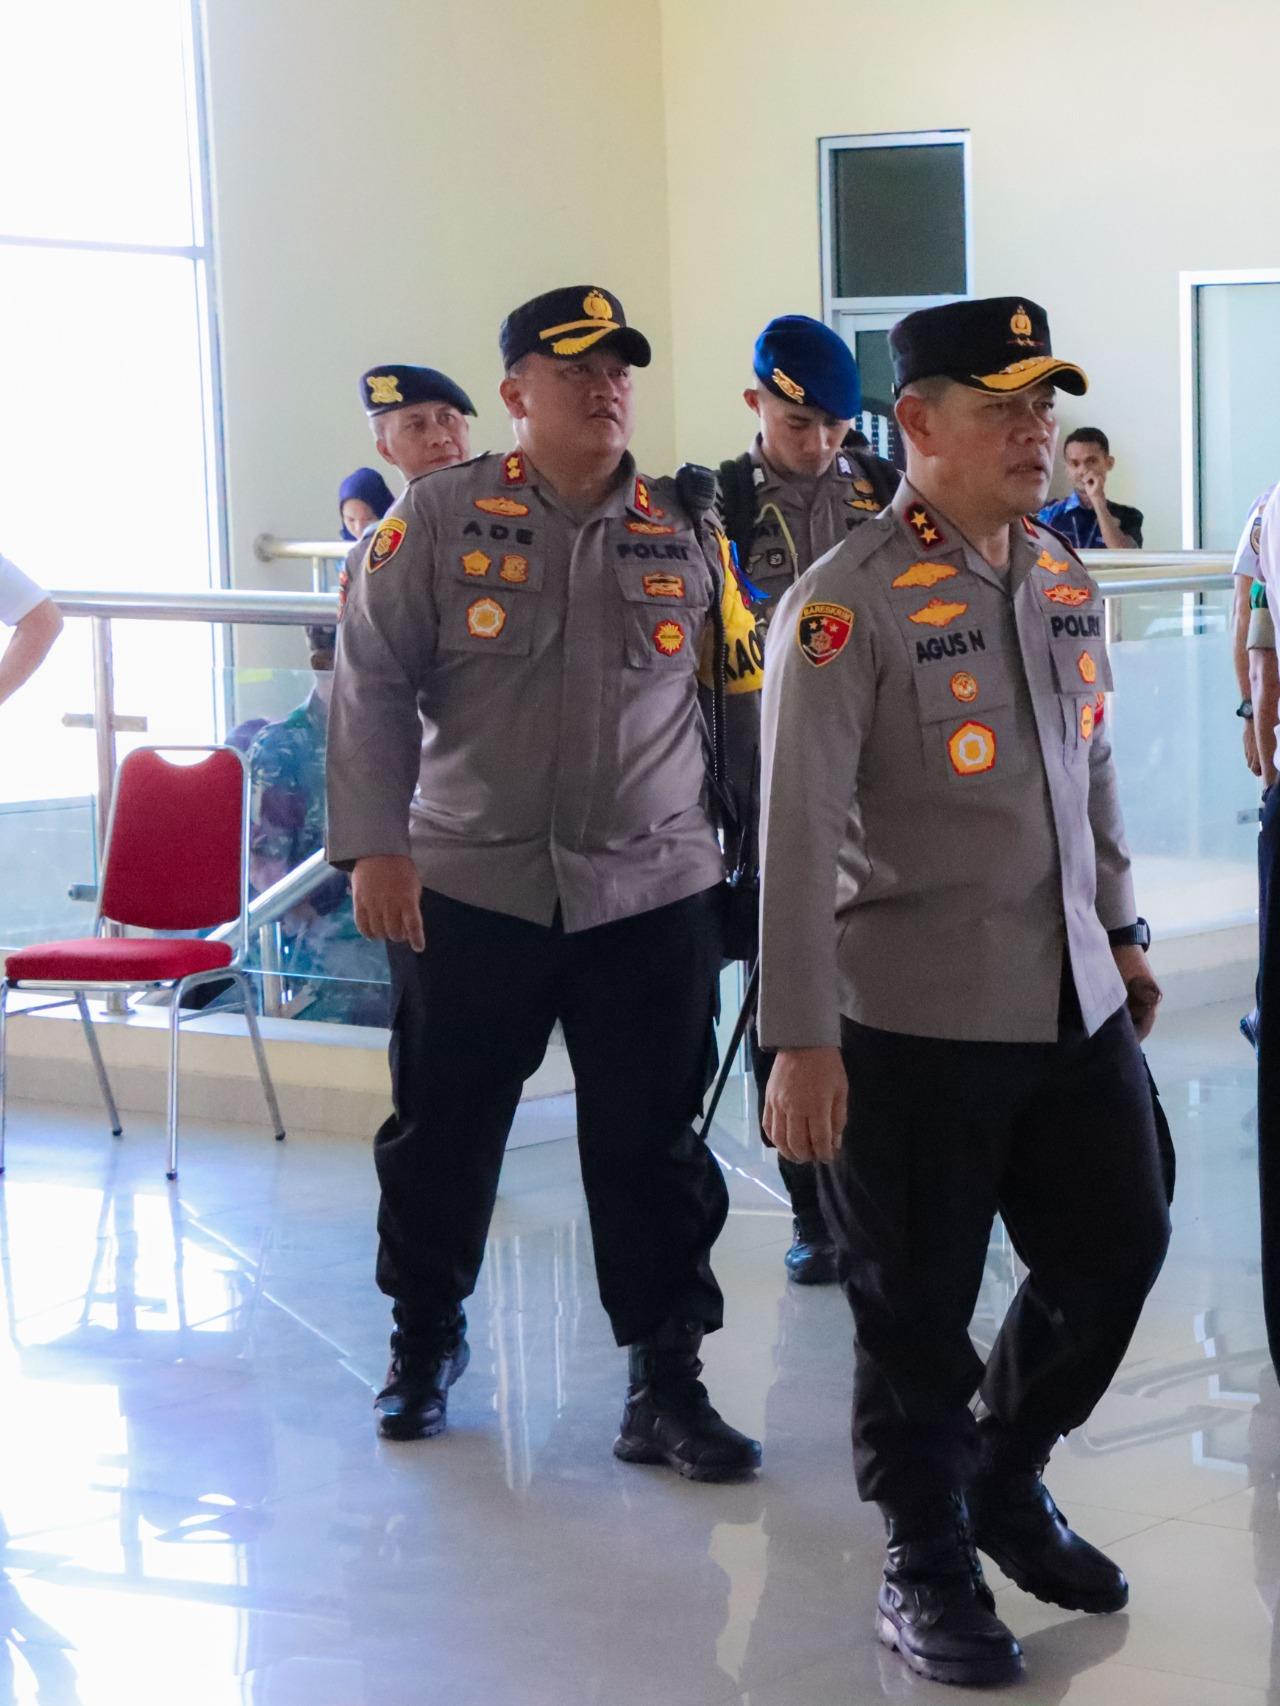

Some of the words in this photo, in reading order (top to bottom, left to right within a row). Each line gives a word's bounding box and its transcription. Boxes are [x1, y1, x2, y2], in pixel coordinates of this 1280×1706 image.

[462, 520, 534, 546] ADE
[616, 542, 690, 562] POLRI
[1050, 614, 1101, 639] POLRI
[916, 632, 969, 665] AGUS
[967, 629, 987, 653] N
